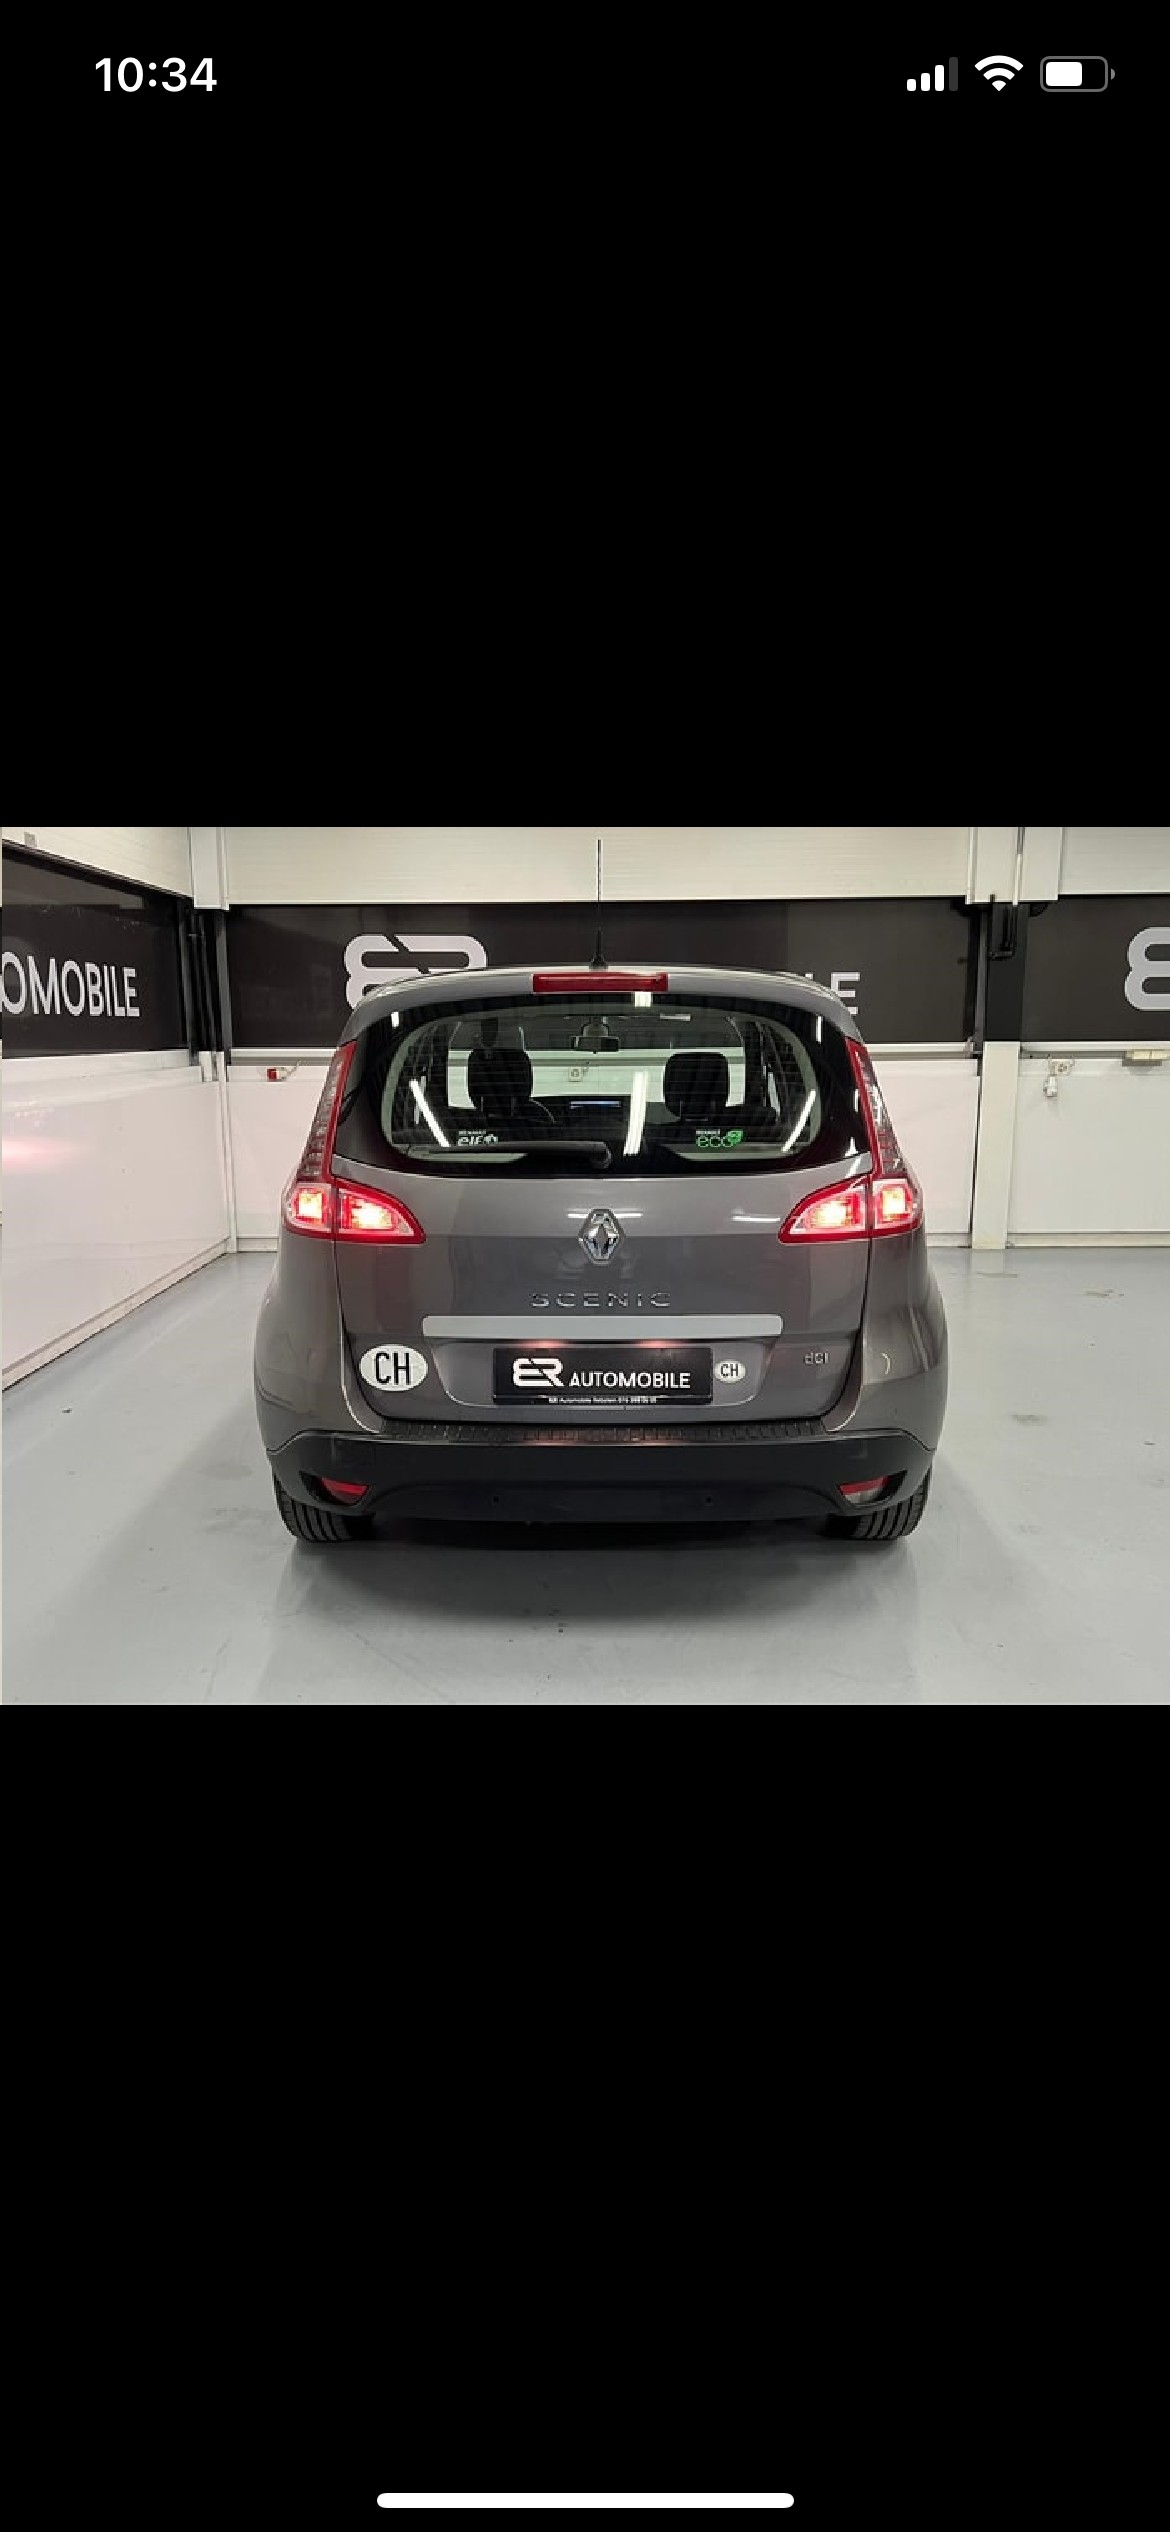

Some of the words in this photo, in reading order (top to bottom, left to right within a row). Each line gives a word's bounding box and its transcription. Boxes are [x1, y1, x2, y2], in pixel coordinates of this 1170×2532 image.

[1, 951, 140, 1017] OMOBILE
[531, 1292, 671, 1307] SCENIC
[375, 1351, 411, 1385] CH
[720, 1363, 739, 1378] CH
[569, 1372, 691, 1389] AUTOMOBILE
